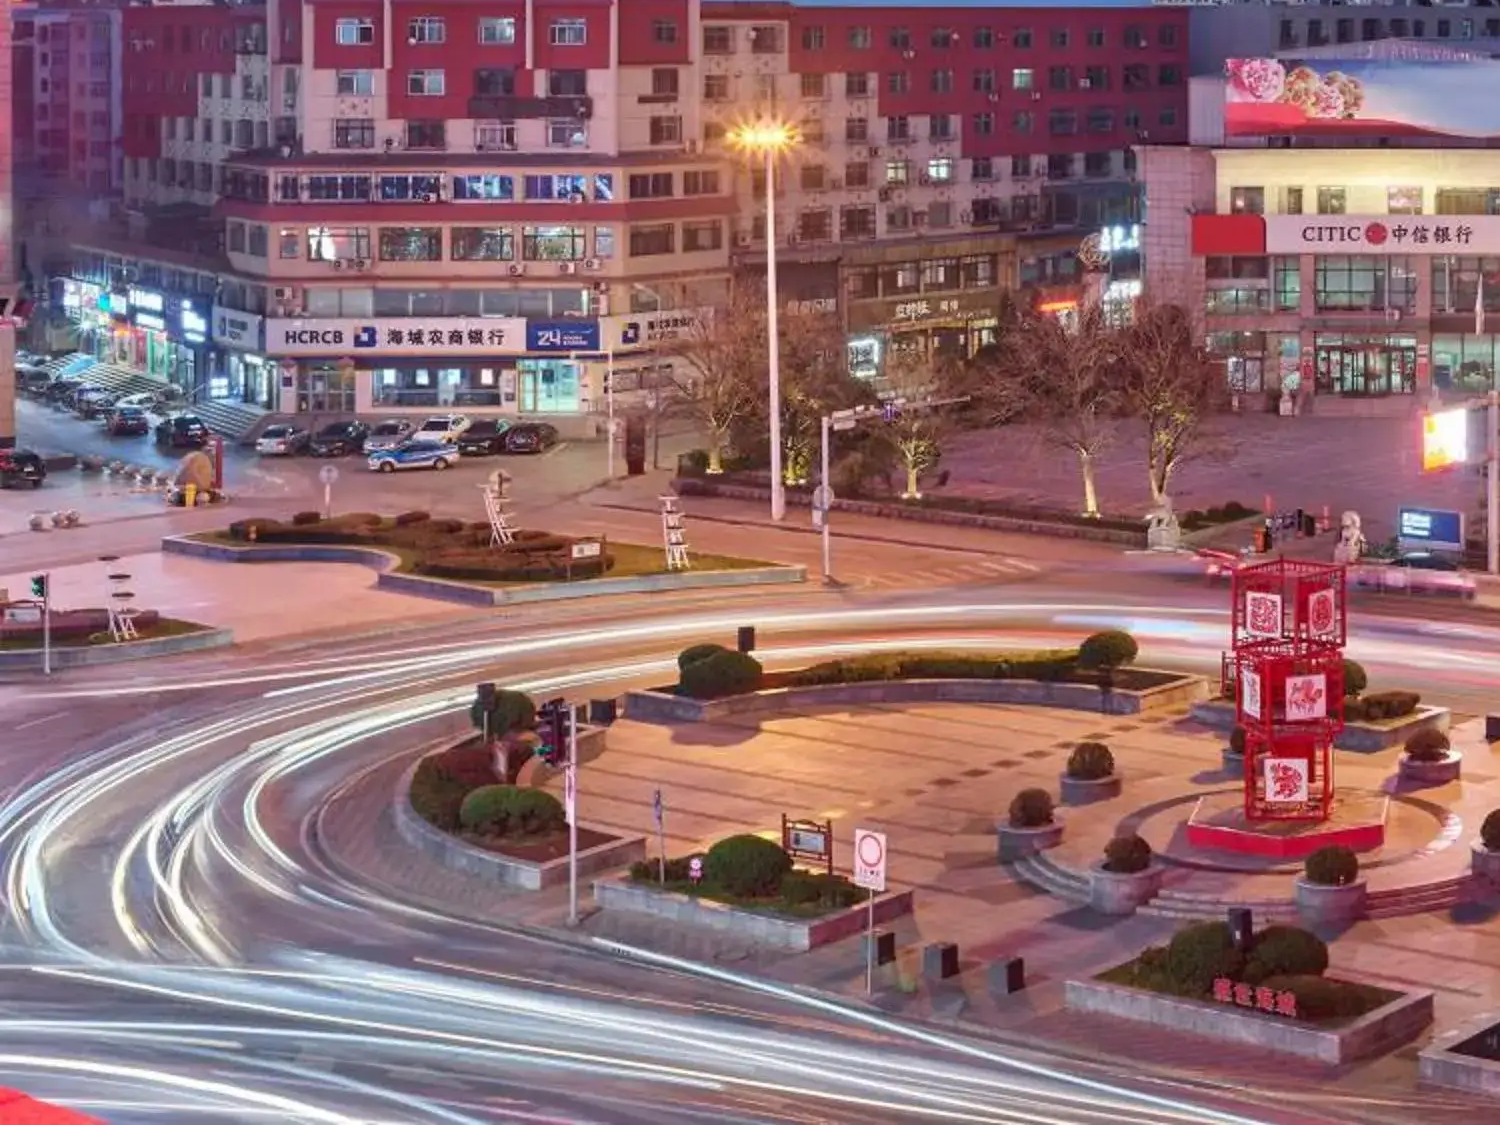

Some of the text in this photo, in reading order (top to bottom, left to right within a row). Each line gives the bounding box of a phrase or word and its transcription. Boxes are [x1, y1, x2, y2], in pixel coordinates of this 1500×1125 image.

[1302, 224, 1473, 244] CITIC 中信银行
[285, 328, 504, 346] HCRCB 海城农商银行
[537, 329, 561, 346] 24
